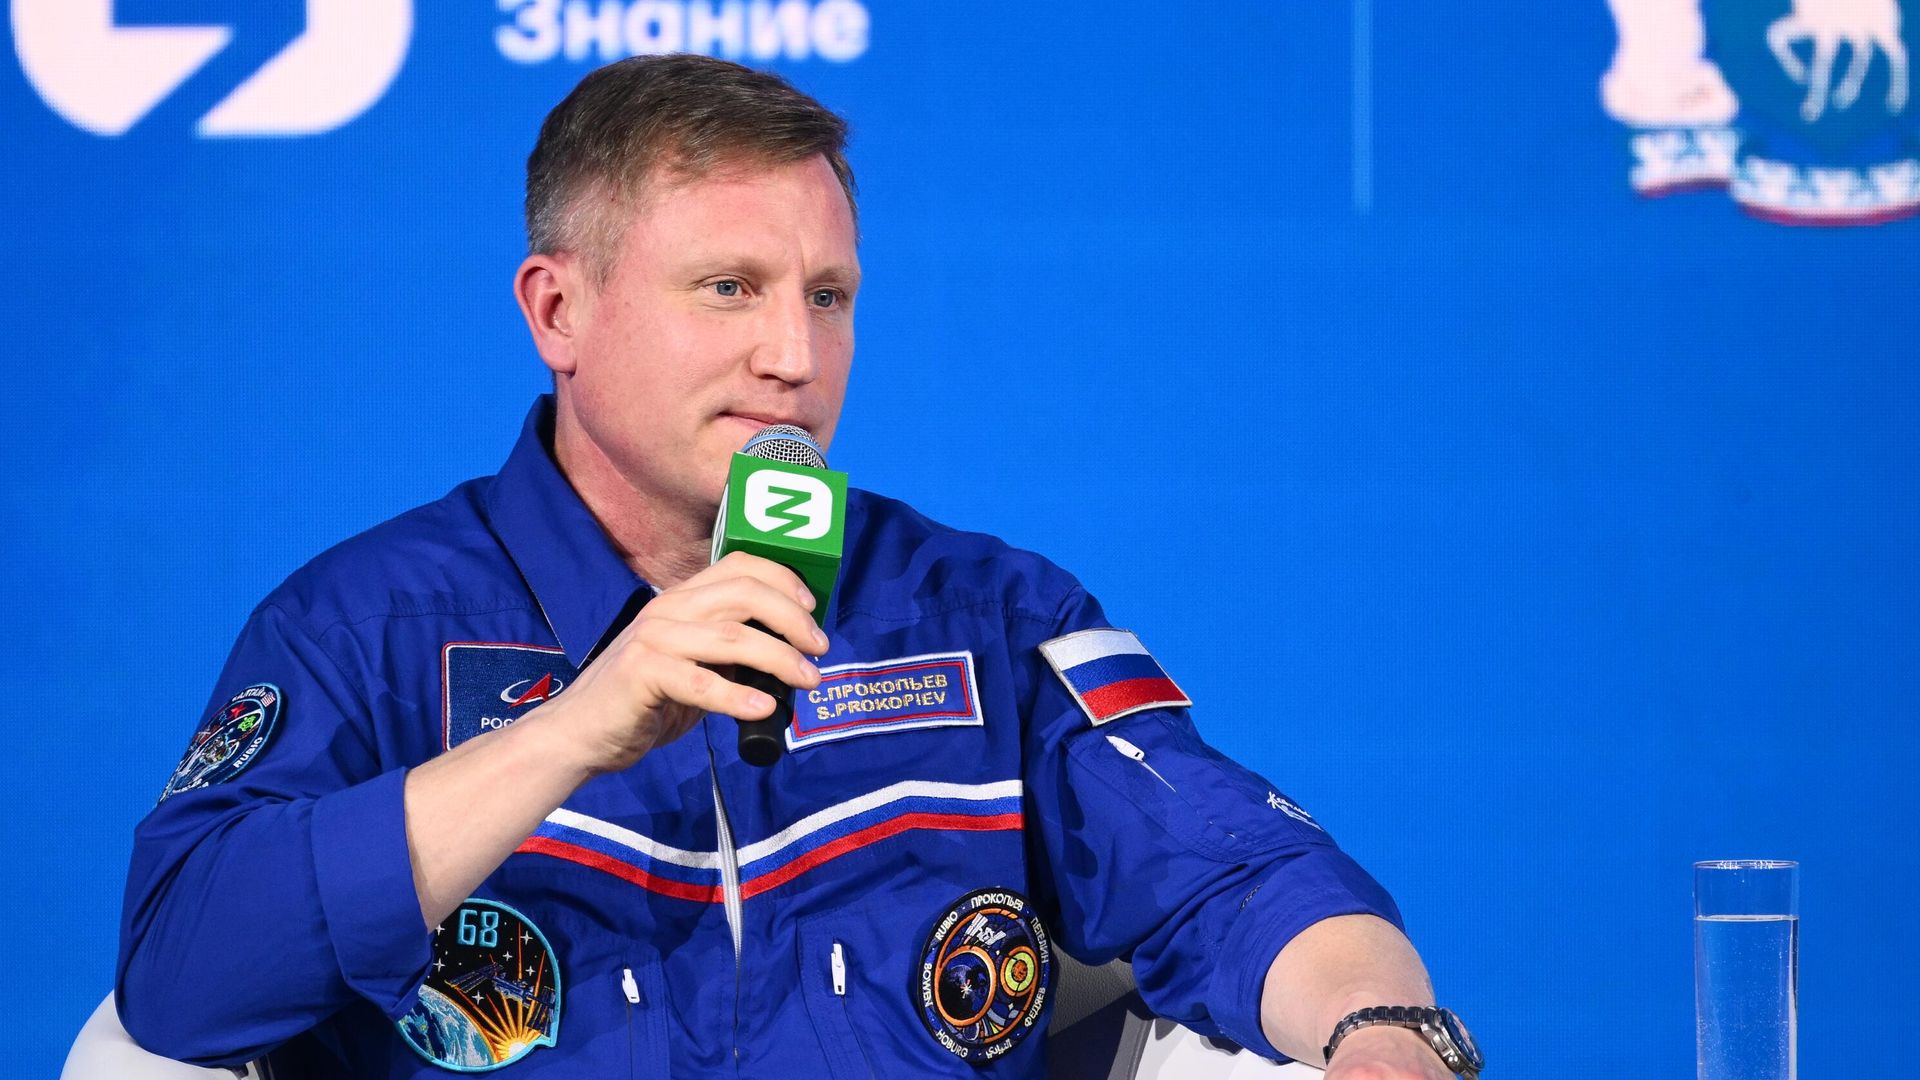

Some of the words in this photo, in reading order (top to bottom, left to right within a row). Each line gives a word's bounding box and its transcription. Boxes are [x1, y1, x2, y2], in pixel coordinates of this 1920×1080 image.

[494, 0, 870, 62] Знание
[808, 673, 948, 704] С.ПРОКОПЬЕВ
[816, 691, 946, 720] S.PROKOPIEV
[233, 736, 263, 768] RUBIO
[970, 893, 1025, 912] ПРОКОПЬЕВ
[458, 909, 499, 948] 68
[934, 911, 959, 941] RUBIO
[1030, 916, 1049, 964] ПЕТЕЛИН
[922, 963, 933, 1008] BOWEN
[1024, 987, 1046, 1027] ФЕДЯЕВ
[935, 1030, 969, 1058] HOBURG
